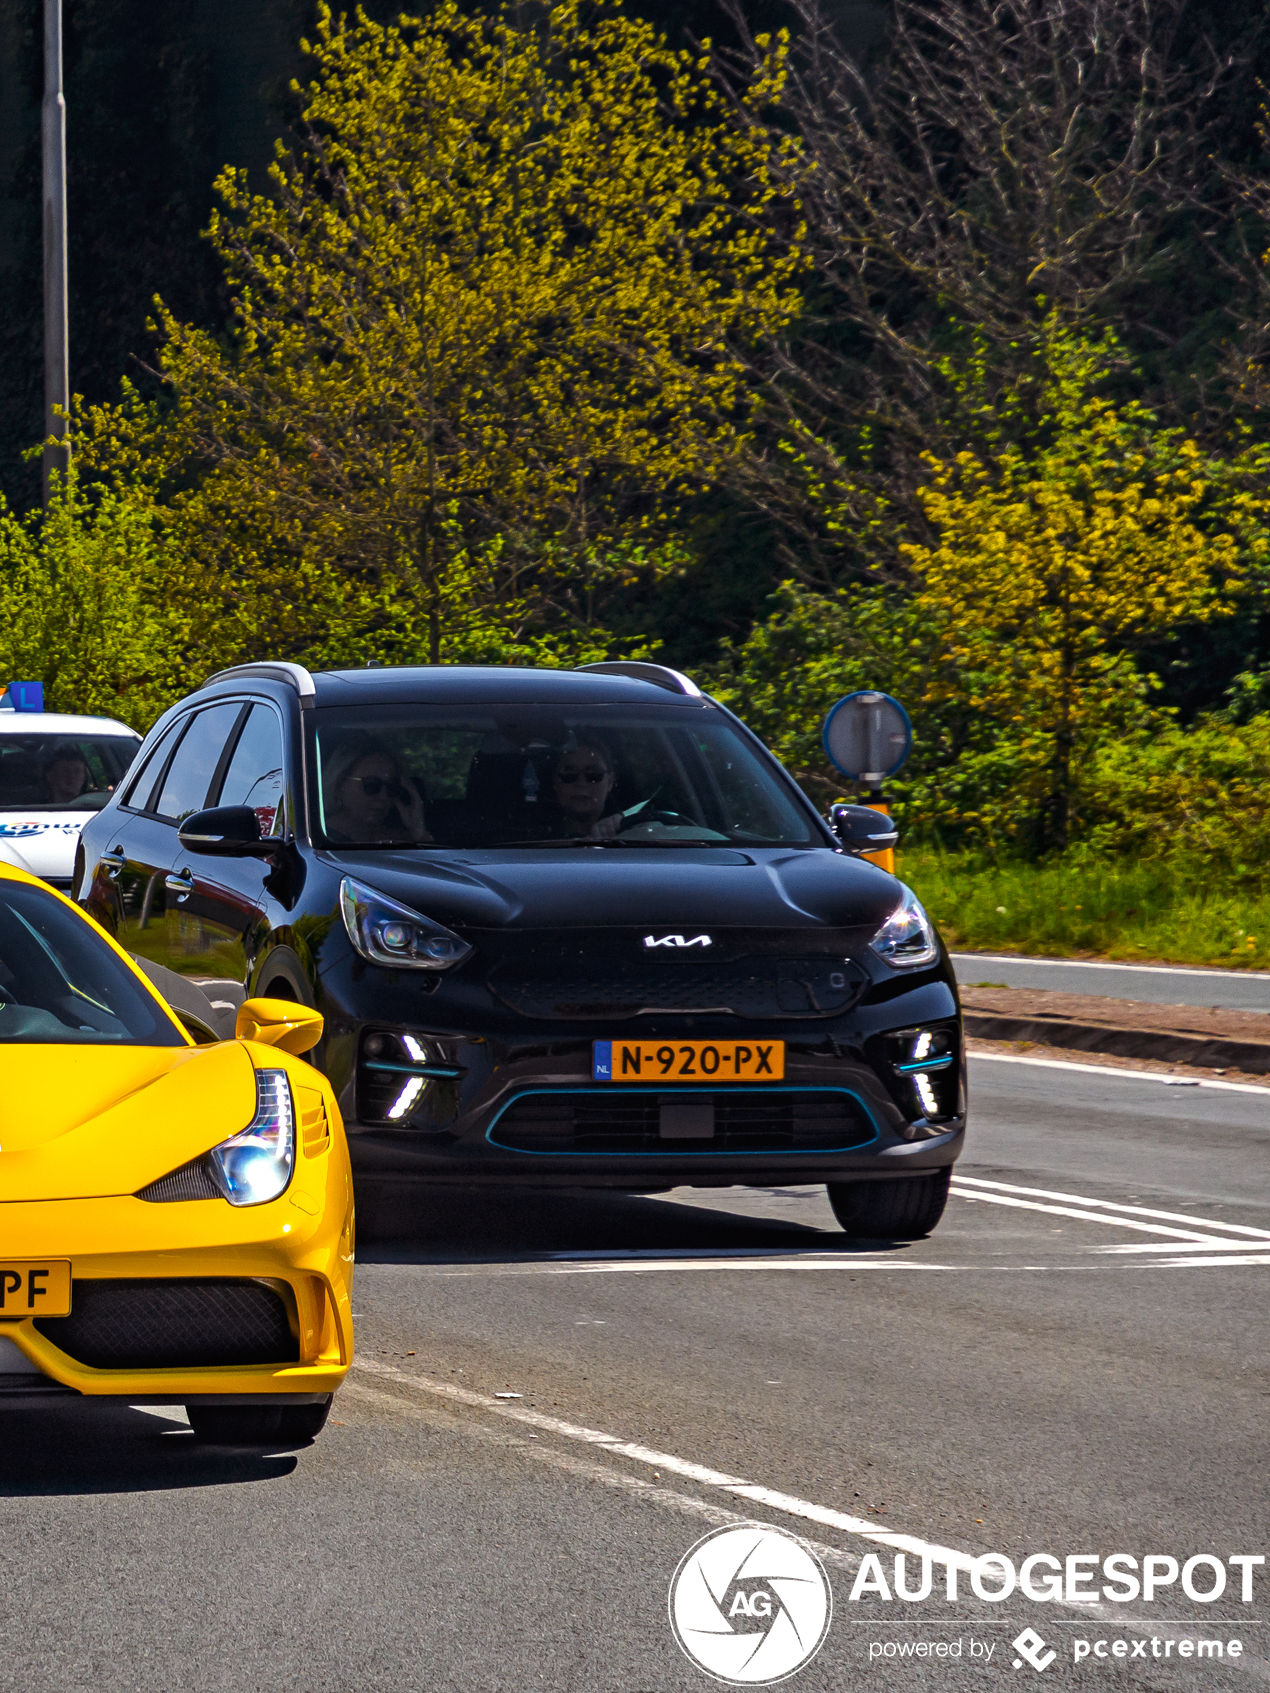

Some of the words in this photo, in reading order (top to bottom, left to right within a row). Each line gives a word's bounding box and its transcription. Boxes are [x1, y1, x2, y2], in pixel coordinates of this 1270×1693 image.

[20, 687, 35, 708] L
[596, 1065, 610, 1074] NL
[621, 1046, 773, 1075] N-920-PX
